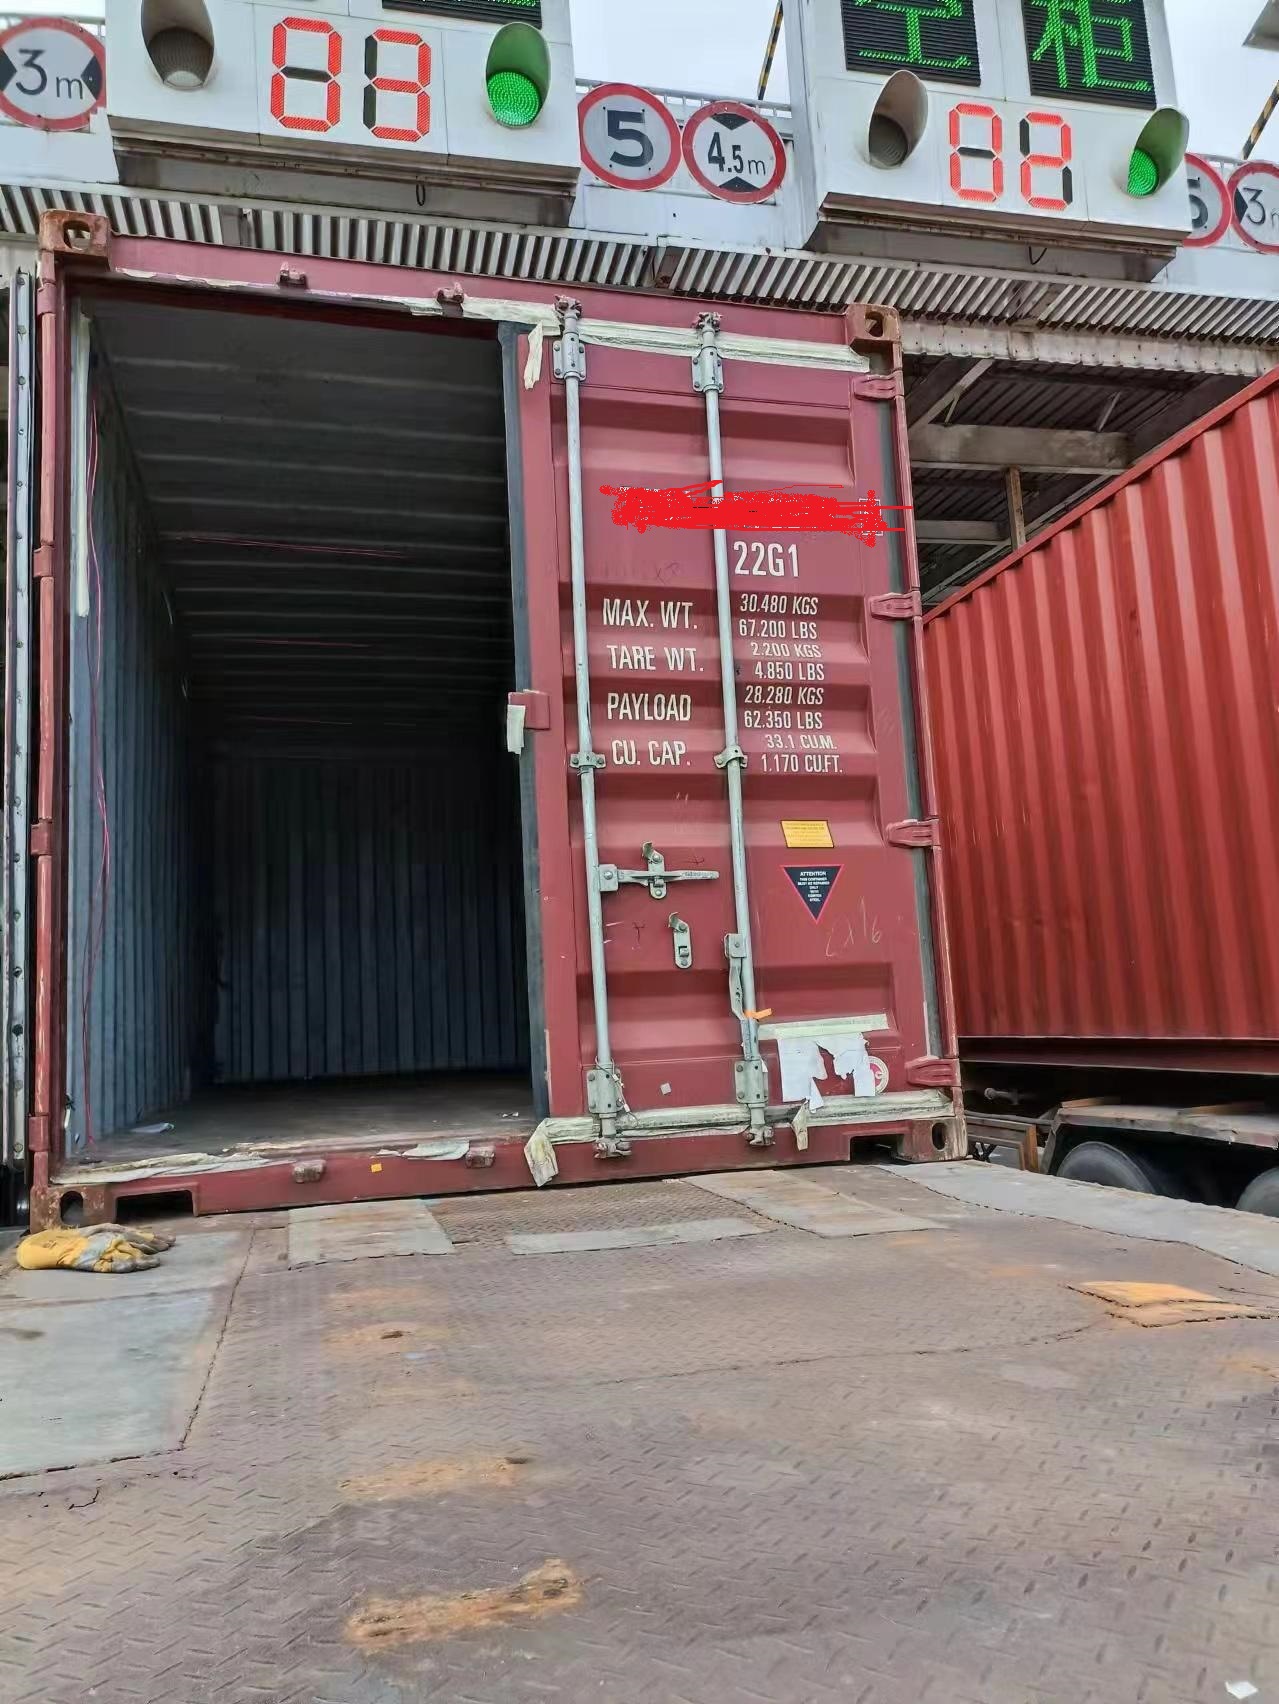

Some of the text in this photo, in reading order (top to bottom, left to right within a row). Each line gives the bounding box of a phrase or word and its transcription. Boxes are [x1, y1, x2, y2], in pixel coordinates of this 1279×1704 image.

[270, 16, 432, 142] 03
[607, 110, 653, 167] 5
[949, 102, 1073, 211] 02
[733, 540, 801, 577] 22G1
[602, 598, 698, 629] MAX. WT.
[740, 593, 819, 615] 30.480 KGS
[739, 619, 818, 639] 67.200 LBS
[606, 645, 704, 671] TARE WT.
[750, 642, 822, 658] 2.200 KGS
[754, 661, 825, 681] 4.850 LBS
[607, 692, 692, 721] PAYLOAD
[744, 685, 825, 705] 28.280 KGS
[744, 710, 823, 730] 62.350 LBS
[611, 739, 691, 767] CU. CAP.
[764, 734, 796, 749] 33.1
[761, 754, 799, 773] 1.170
